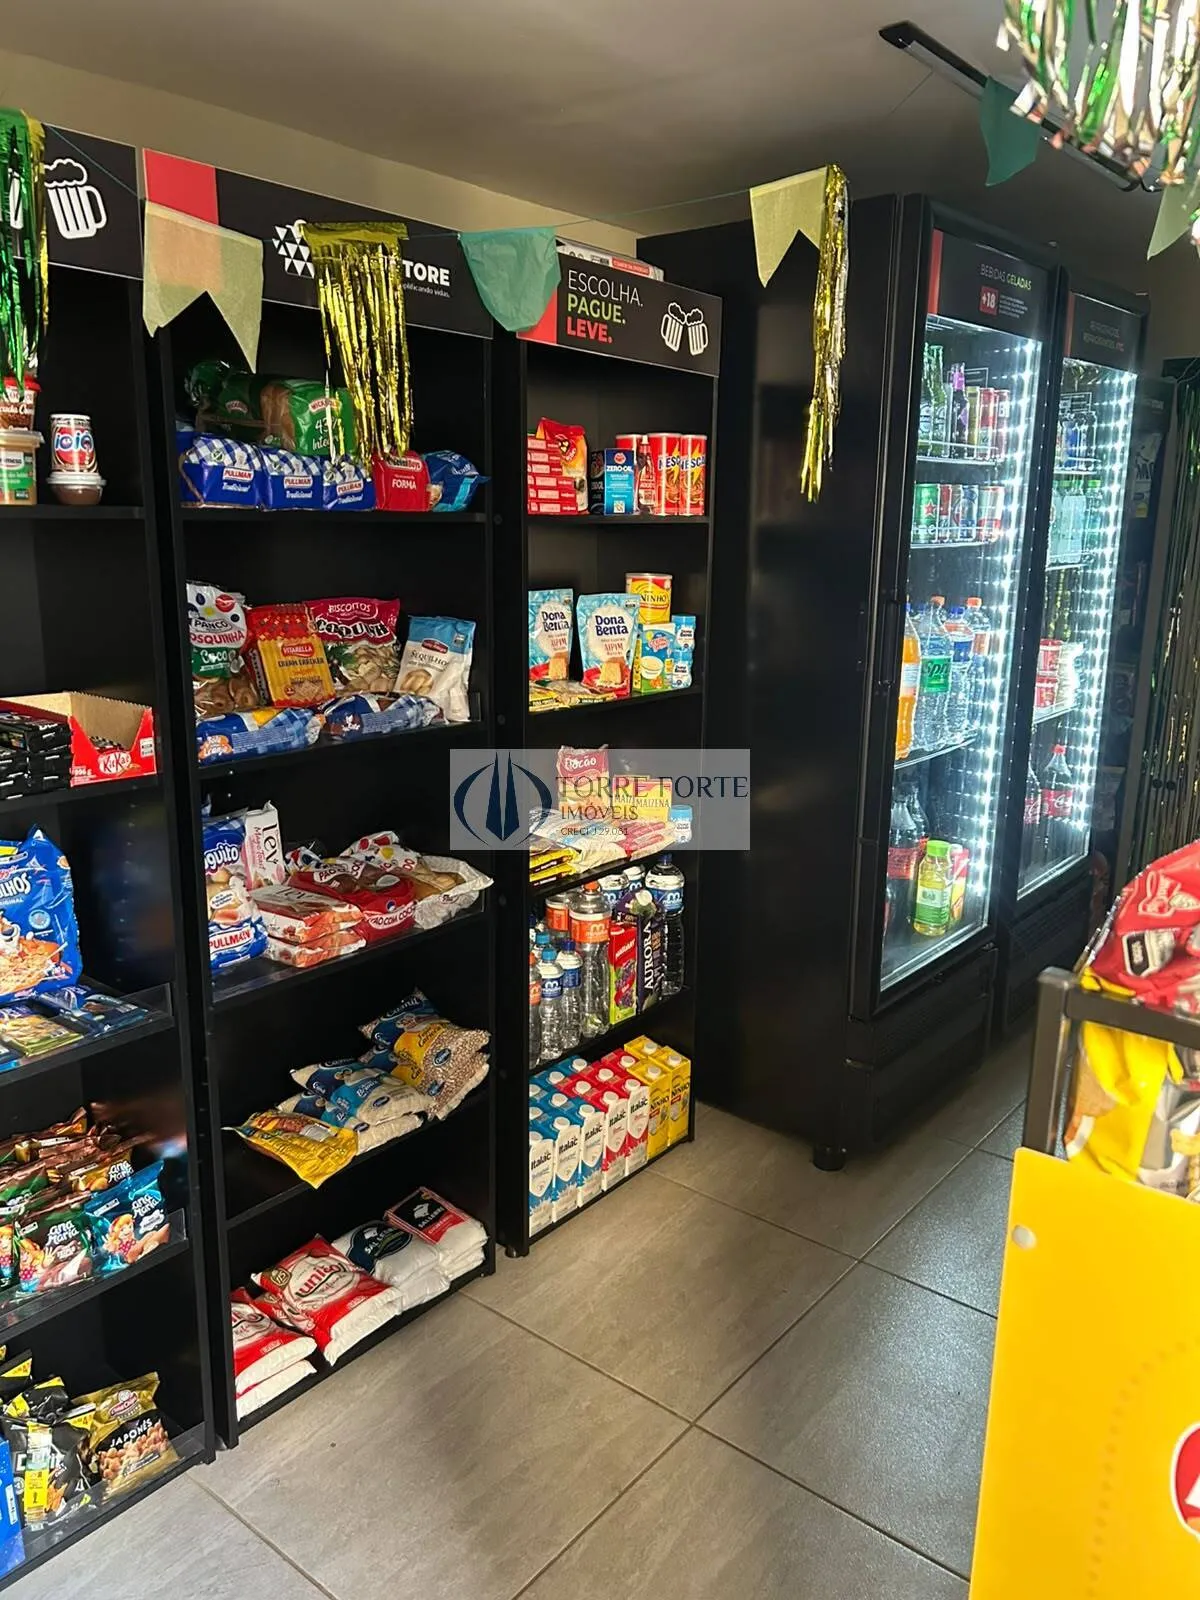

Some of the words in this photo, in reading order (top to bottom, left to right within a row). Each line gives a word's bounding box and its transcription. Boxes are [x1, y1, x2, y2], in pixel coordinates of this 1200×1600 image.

[401, 259, 450, 287] TORE
[1006, 272, 1033, 291] GELADAS
[568, 269, 644, 308] ESCOLHA.
[982, 292, 997, 309] +18
[567, 292, 627, 325] PAGUE.
[566, 316, 613, 344] LEVE.
[224, 470, 252, 479] PULLMAN
[284, 478, 312, 486] PULLMAN
[337, 481, 363, 493] PULLMAN
[392, 479, 417, 490] FORMA
[328, 602, 371, 613] BISCOITOS
[541, 611, 566, 621] Dona
[595, 615, 625, 626] Dona
[195, 620, 228, 629] PANCO
[543, 620, 570, 632] Benta
[595, 624, 629, 637] Benta
[190, 630, 245, 645] OSQUINHA
[635, 799, 670, 808] MAIZENA
[643, 921, 654, 989] AURORA
